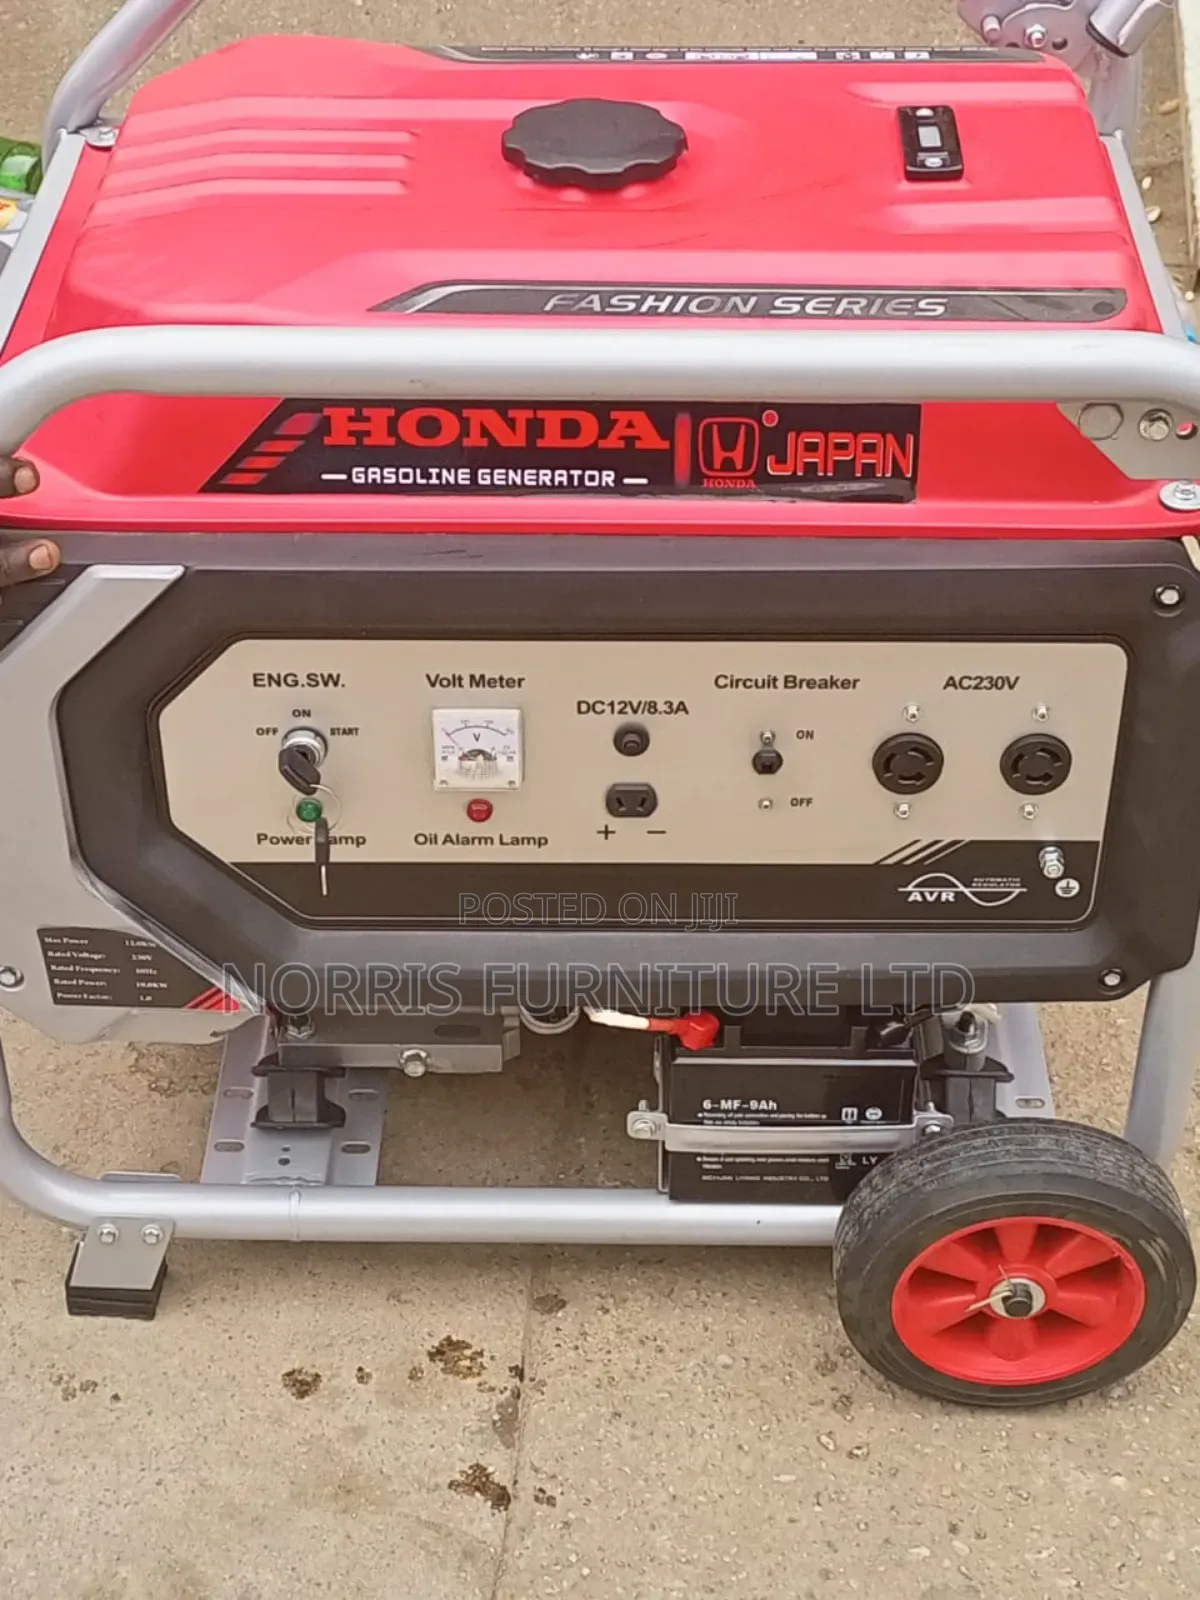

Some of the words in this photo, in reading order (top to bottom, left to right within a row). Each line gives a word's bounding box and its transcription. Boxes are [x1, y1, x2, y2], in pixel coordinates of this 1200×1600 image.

[544, 293, 757, 314] FASHION
[769, 296, 948, 317] SERIES
[322, 407, 670, 449] HONDA
[766, 431, 914, 478] JAPAN
[351, 467, 471, 486] GASOLINE
[477, 468, 616, 488] GENERATOR
[703, 478, 757, 489] HONDA
[252, 673, 346, 688] ENG.SW.
[425, 673, 464, 689] Volt
[469, 673, 526, 689] Meter
[714, 674, 779, 690] Circuit
[783, 674, 860, 690] Breaker
[943, 675, 1020, 691] AC230V
[292, 708, 312, 718] ON
[576, 700, 689, 716] DC12V/8.3A
[256, 727, 279, 736] OFF
[330, 727, 359, 736] START
[473, 732, 482, 742] V
[796, 730, 815, 740] ON
[790, 797, 813, 807] OFF
[256, 833, 313, 846] Power
[328, 833, 367, 848] amp
[414, 833, 438, 846] Oil
[442, 833, 494, 846] Alarm
[499, 833, 548, 848] Lamp
[907, 891, 956, 902] AVR
[702, 1099, 777, 1110] 6-MF-9Ah
